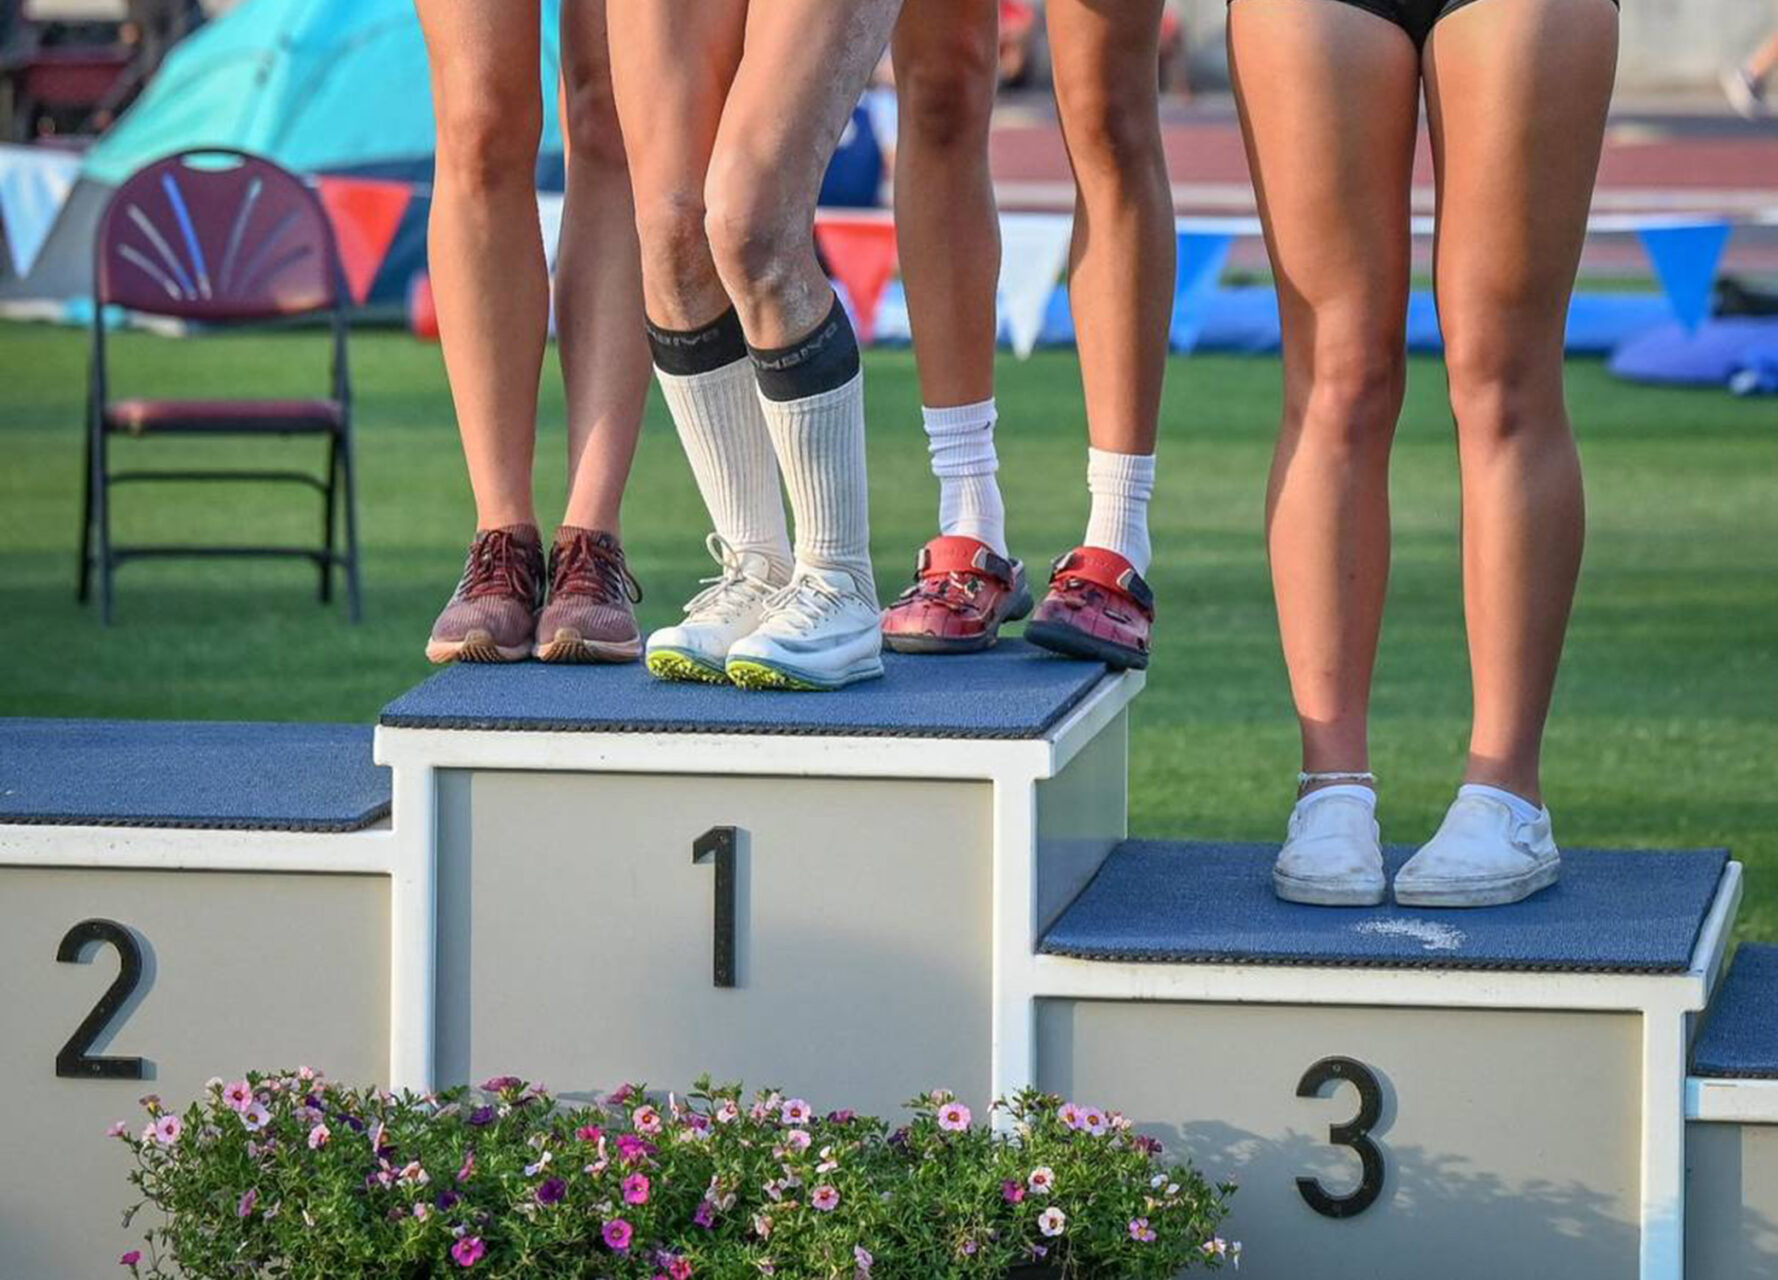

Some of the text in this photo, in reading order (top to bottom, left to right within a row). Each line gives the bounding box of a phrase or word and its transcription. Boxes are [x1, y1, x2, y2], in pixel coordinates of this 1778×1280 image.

[692, 825, 736, 988] 1
[56, 917, 143, 1078] 2
[1296, 1055, 1386, 1219] 3
